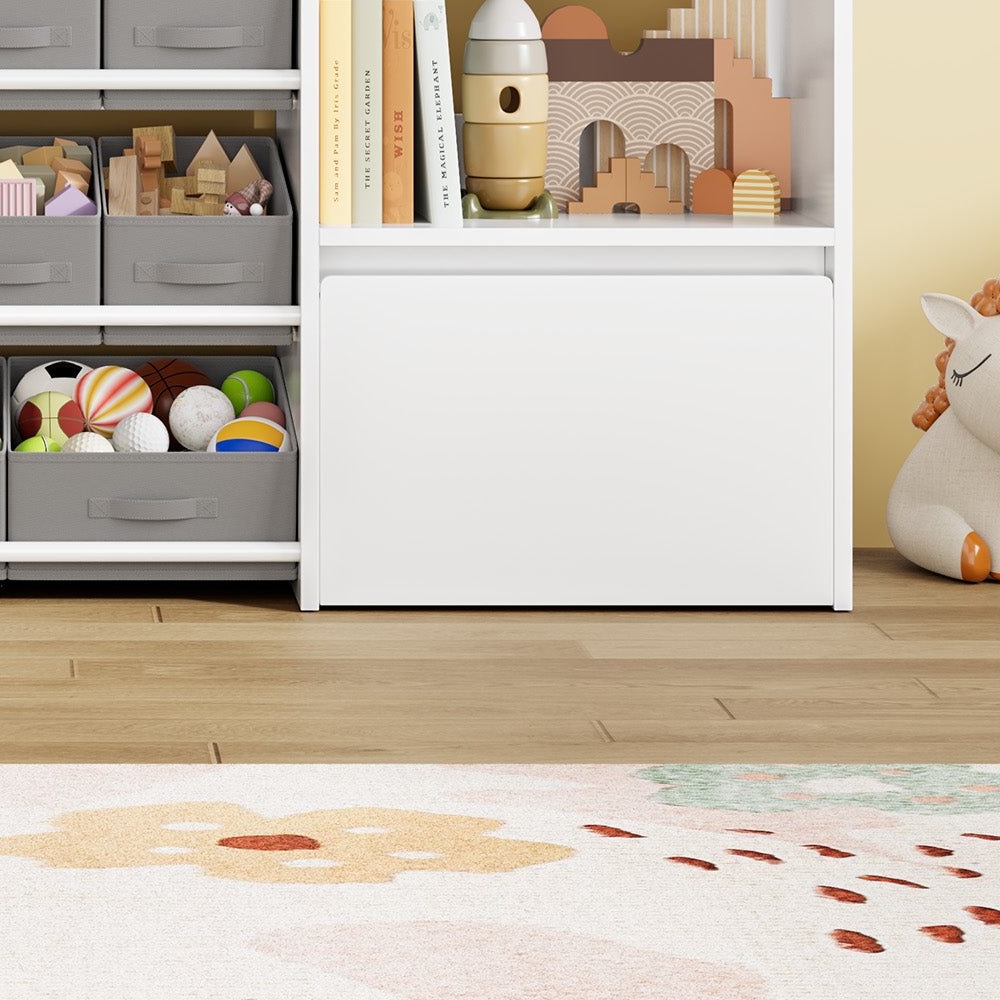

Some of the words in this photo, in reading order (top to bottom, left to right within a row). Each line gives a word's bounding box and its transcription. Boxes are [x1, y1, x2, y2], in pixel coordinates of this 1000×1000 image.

[431, 60, 442, 121] ELEPHANT
[393, 110, 403, 159] WISH
[438, 126, 448, 179] MAGICAL
